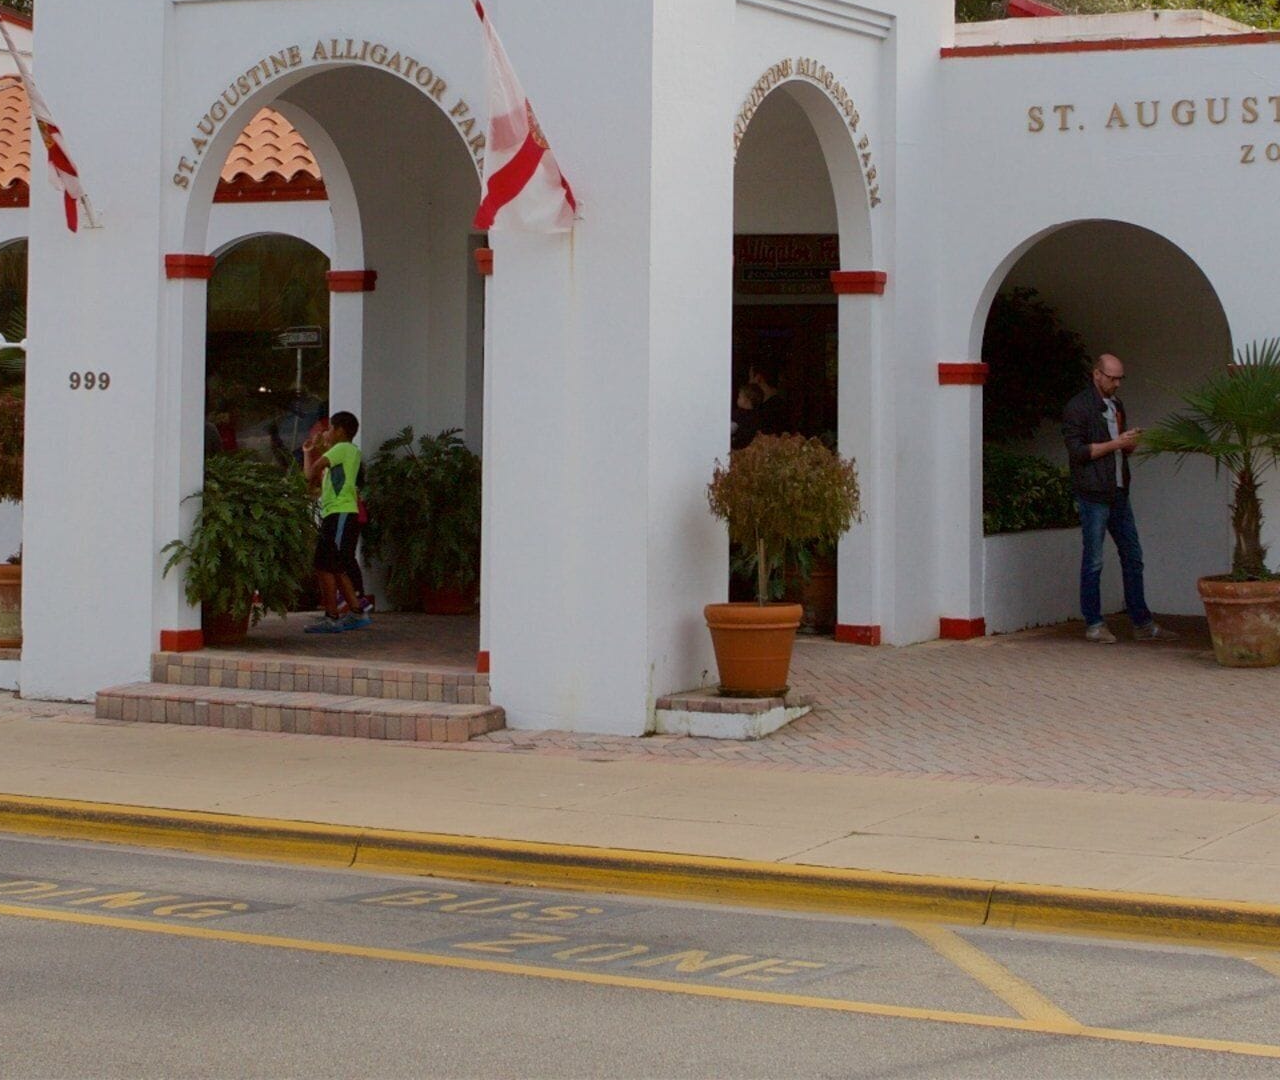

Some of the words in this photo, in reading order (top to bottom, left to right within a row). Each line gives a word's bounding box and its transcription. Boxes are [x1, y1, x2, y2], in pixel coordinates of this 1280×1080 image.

[173, 156, 198, 189] ST.
[192, 45, 302, 155] AUGUSTINE
[312, 38, 447, 102] ALLIGATOR
[1027, 104, 1085, 132] ST.
[69, 371, 111, 390] 999
[359, 890, 603, 921] BUS
[452, 932, 826, 982] ZONE
